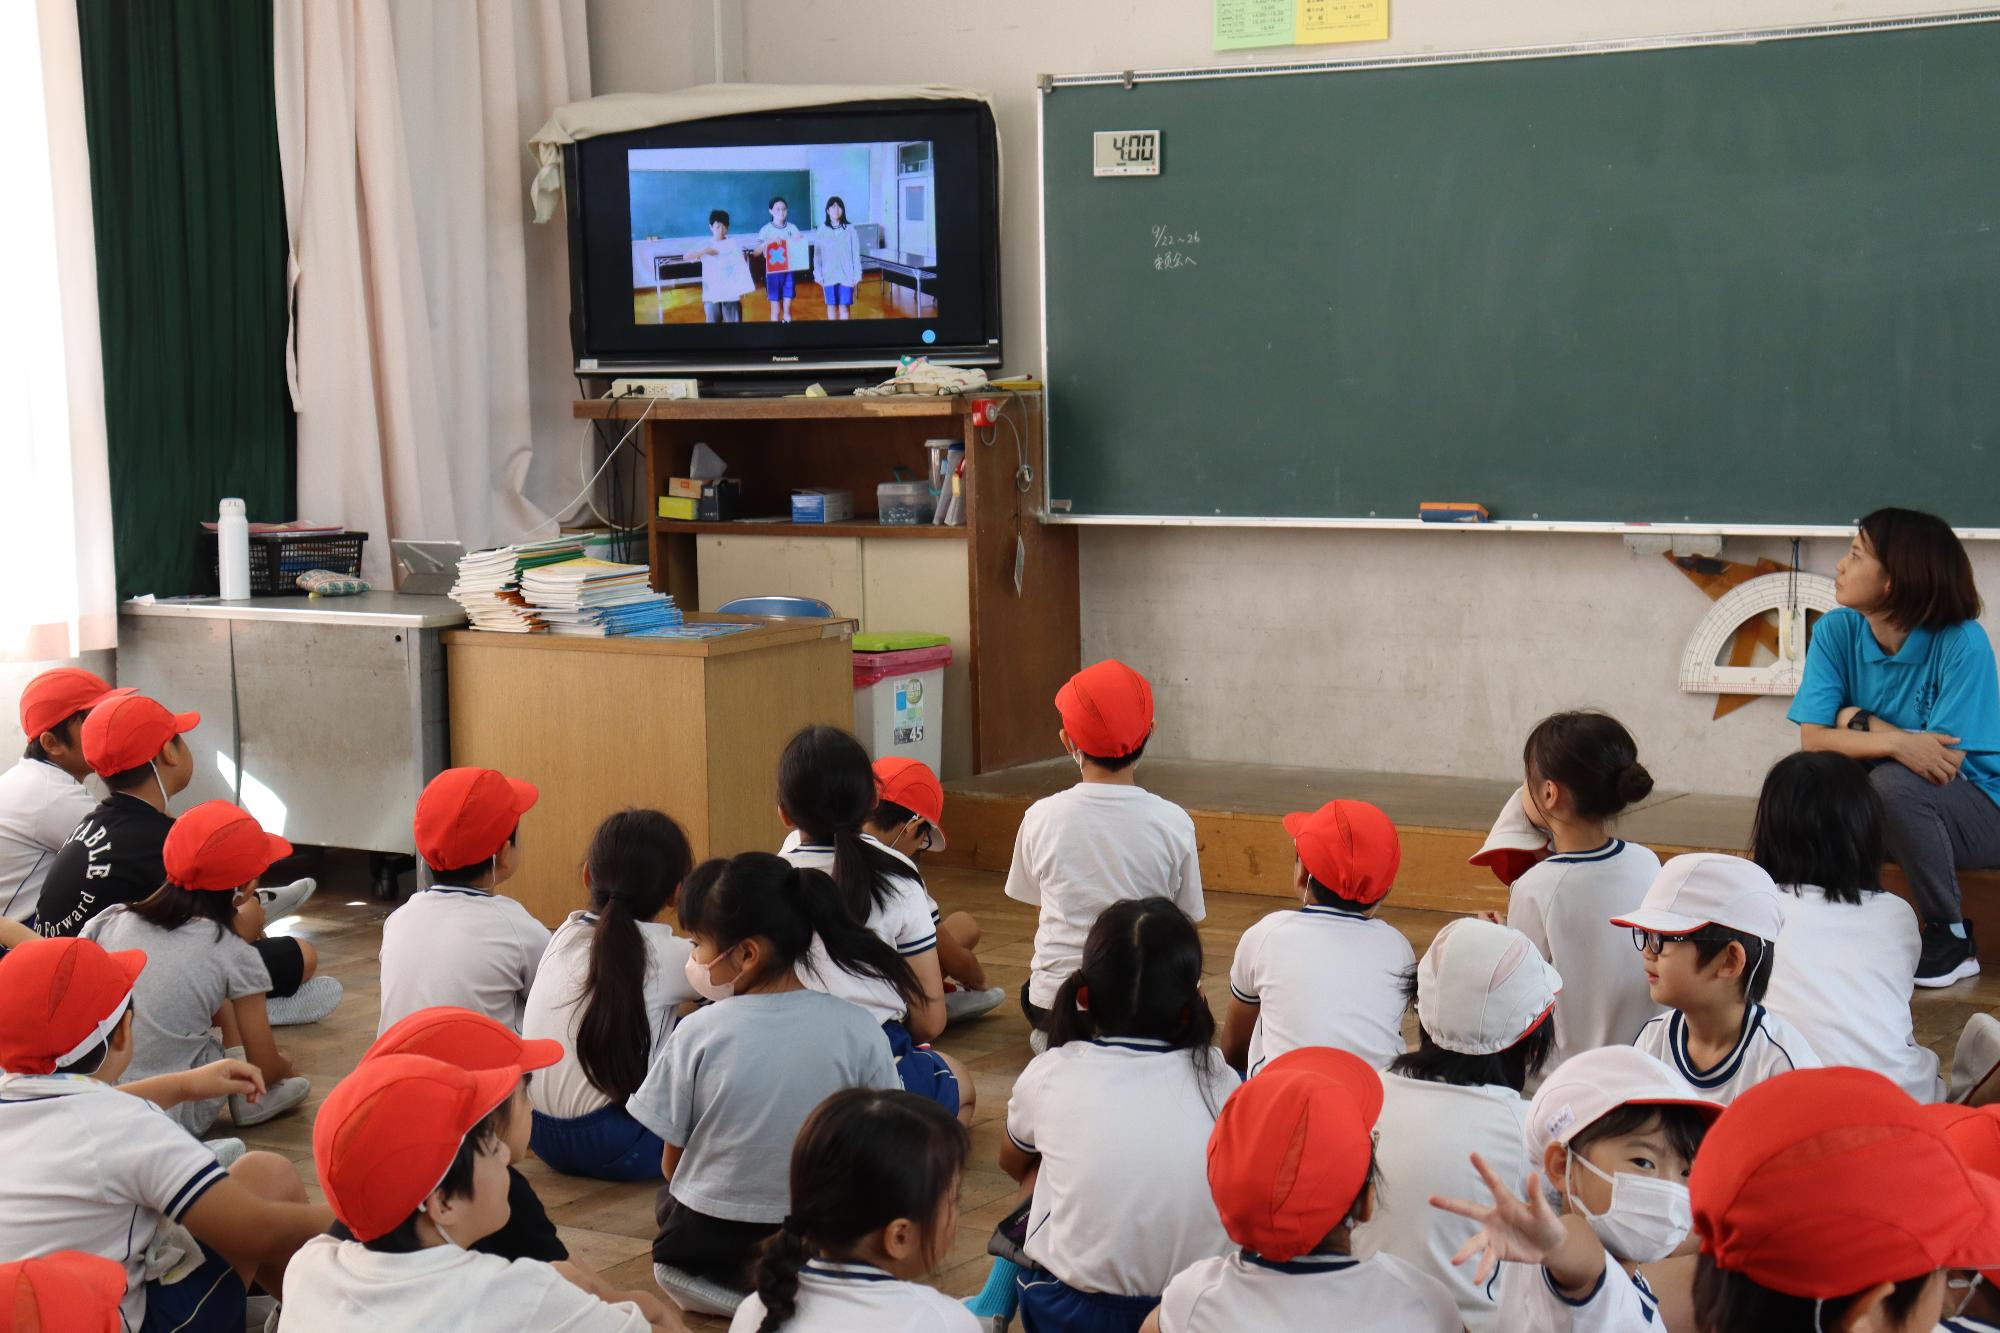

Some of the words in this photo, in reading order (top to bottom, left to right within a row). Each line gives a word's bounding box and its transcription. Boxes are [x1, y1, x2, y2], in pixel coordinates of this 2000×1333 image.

[1113, 135, 1155, 161] 4:00
[909, 727, 923, 742] 45
[44, 890, 96, 938] Forward
